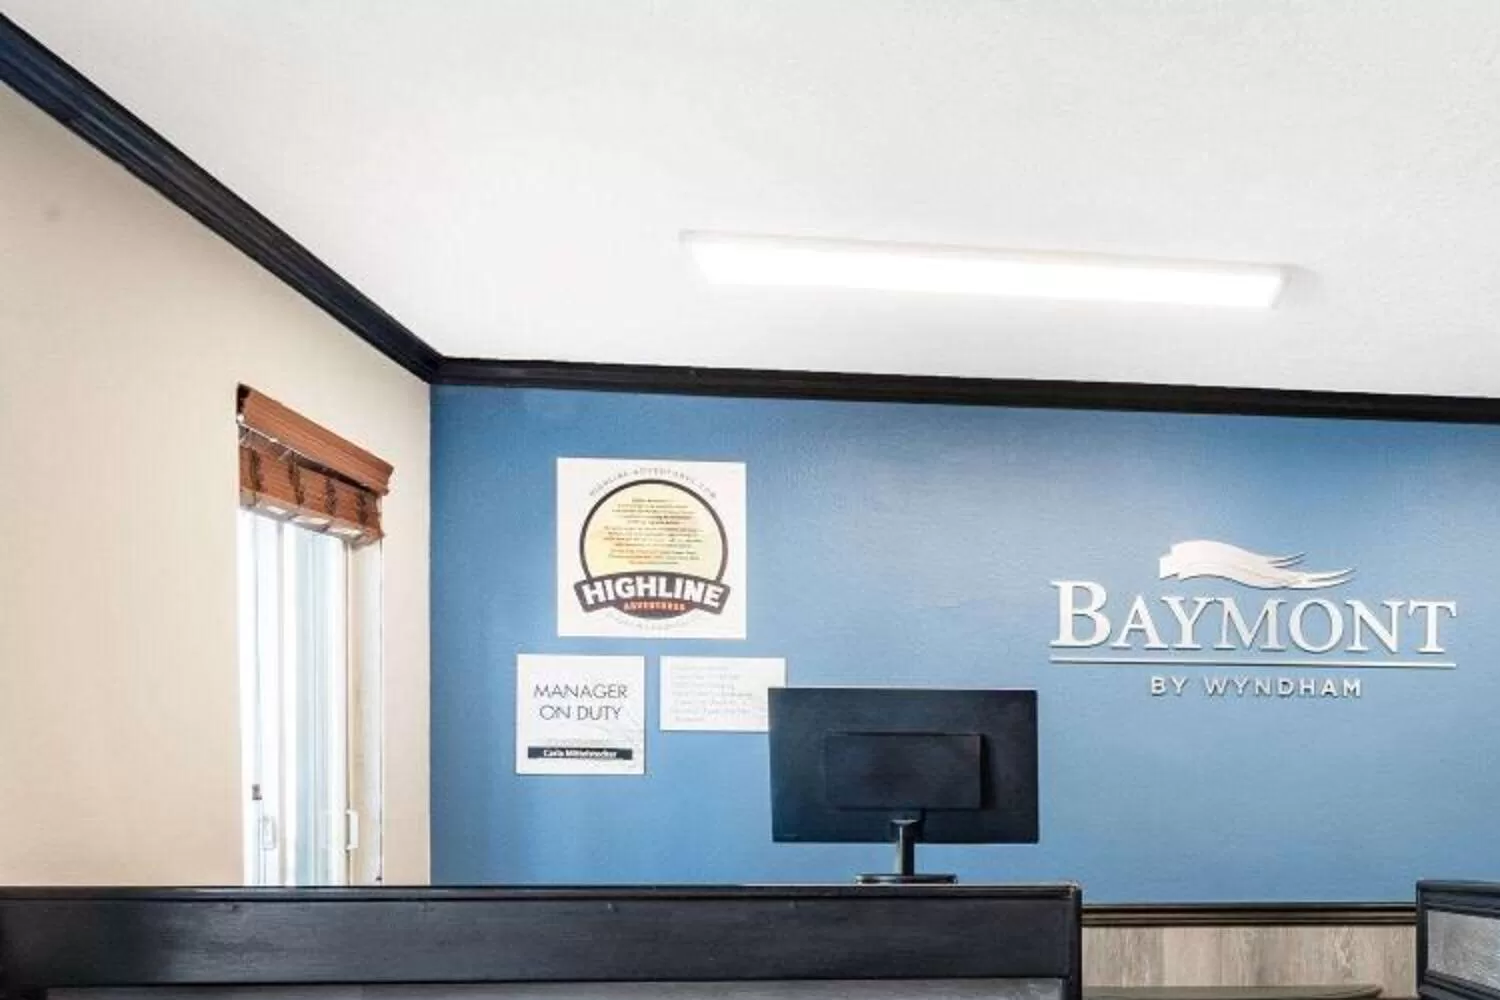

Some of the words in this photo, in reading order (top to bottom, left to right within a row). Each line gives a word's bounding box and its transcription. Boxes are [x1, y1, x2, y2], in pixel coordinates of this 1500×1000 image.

[581, 576, 724, 608] HIGHLINE
[1049, 580, 1457, 654] BAYMONT
[533, 683, 629, 699] MANAGER
[1151, 677, 1188, 696] BY
[1204, 677, 1362, 698] WYNDHAM
[539, 705, 571, 721] ON
[577, 705, 622, 721] DUTY
